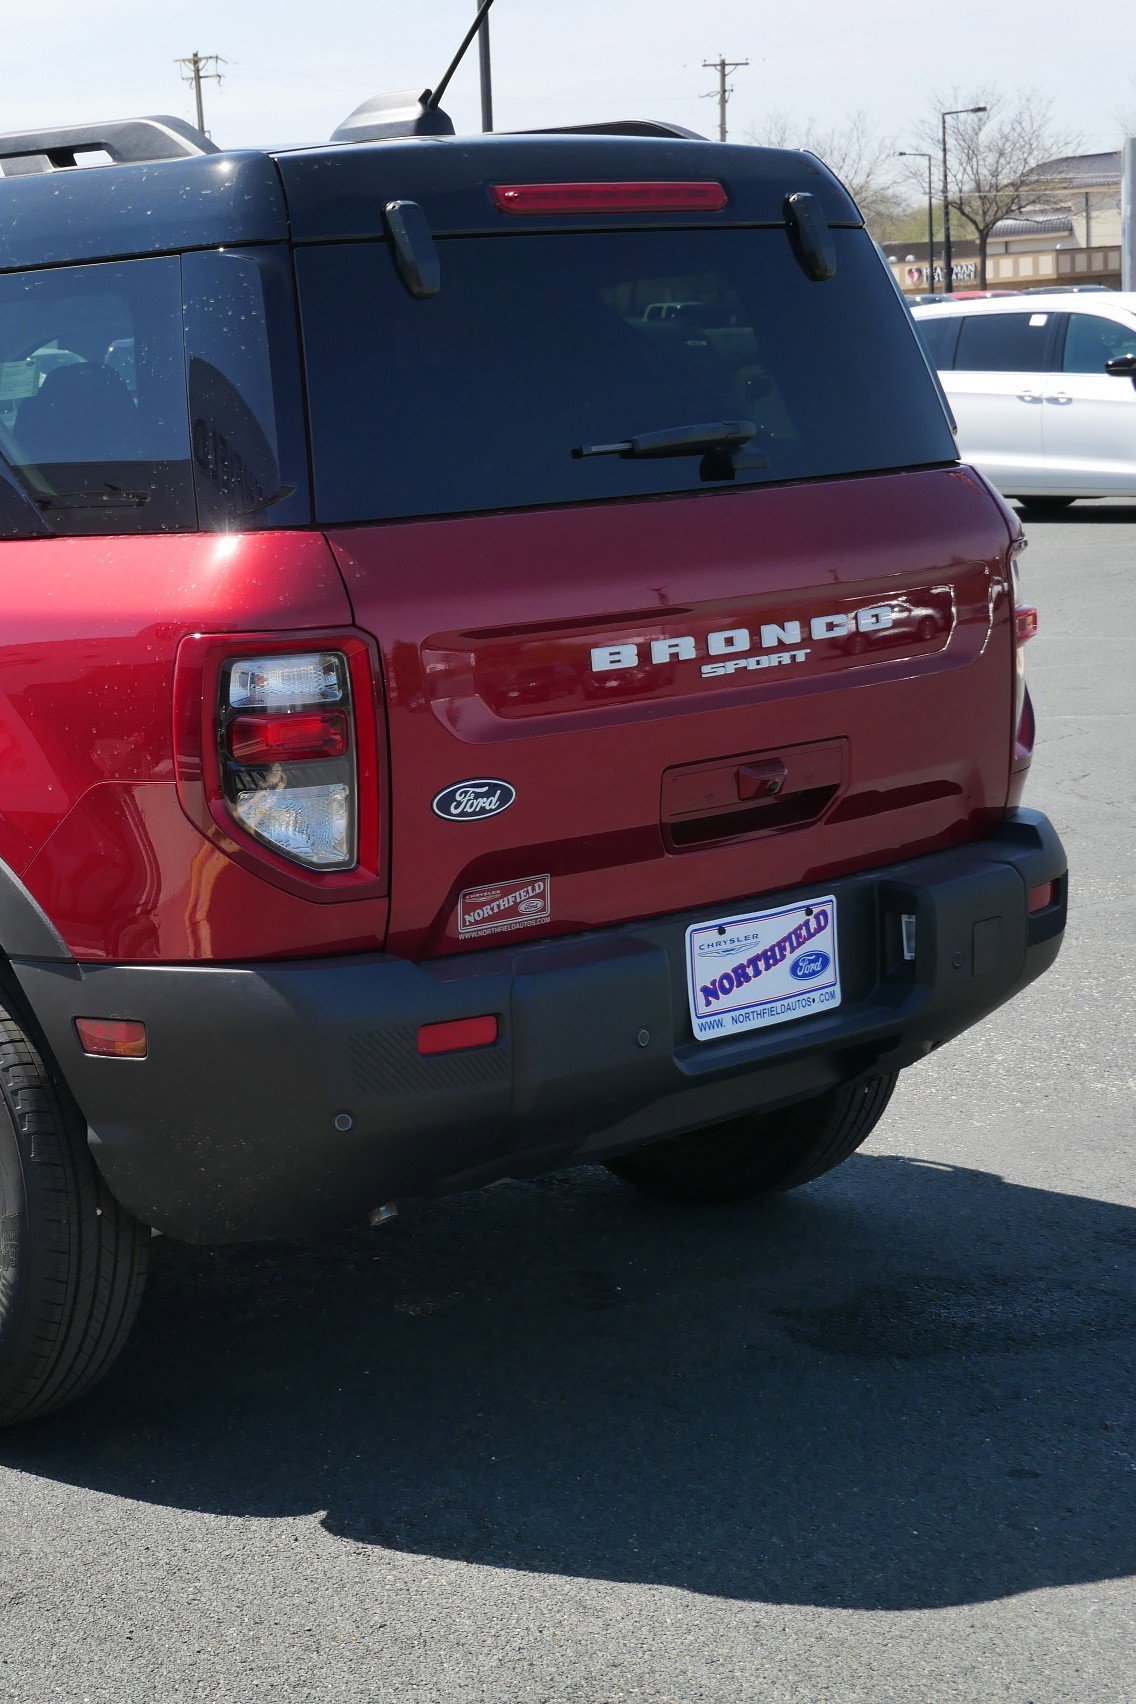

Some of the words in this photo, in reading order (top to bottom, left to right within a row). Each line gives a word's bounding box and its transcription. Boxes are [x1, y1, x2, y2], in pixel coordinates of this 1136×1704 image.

[591, 606, 893, 672] BRONCO
[701, 649, 811, 678] SPORT
[450, 786, 501, 815] Ford
[464, 881, 544, 926] NORTHFIELD
[698, 933, 759, 951] CHRYSLER
[699, 908, 829, 1007] NORTHFIELD
[796, 955, 822, 976] Ford
